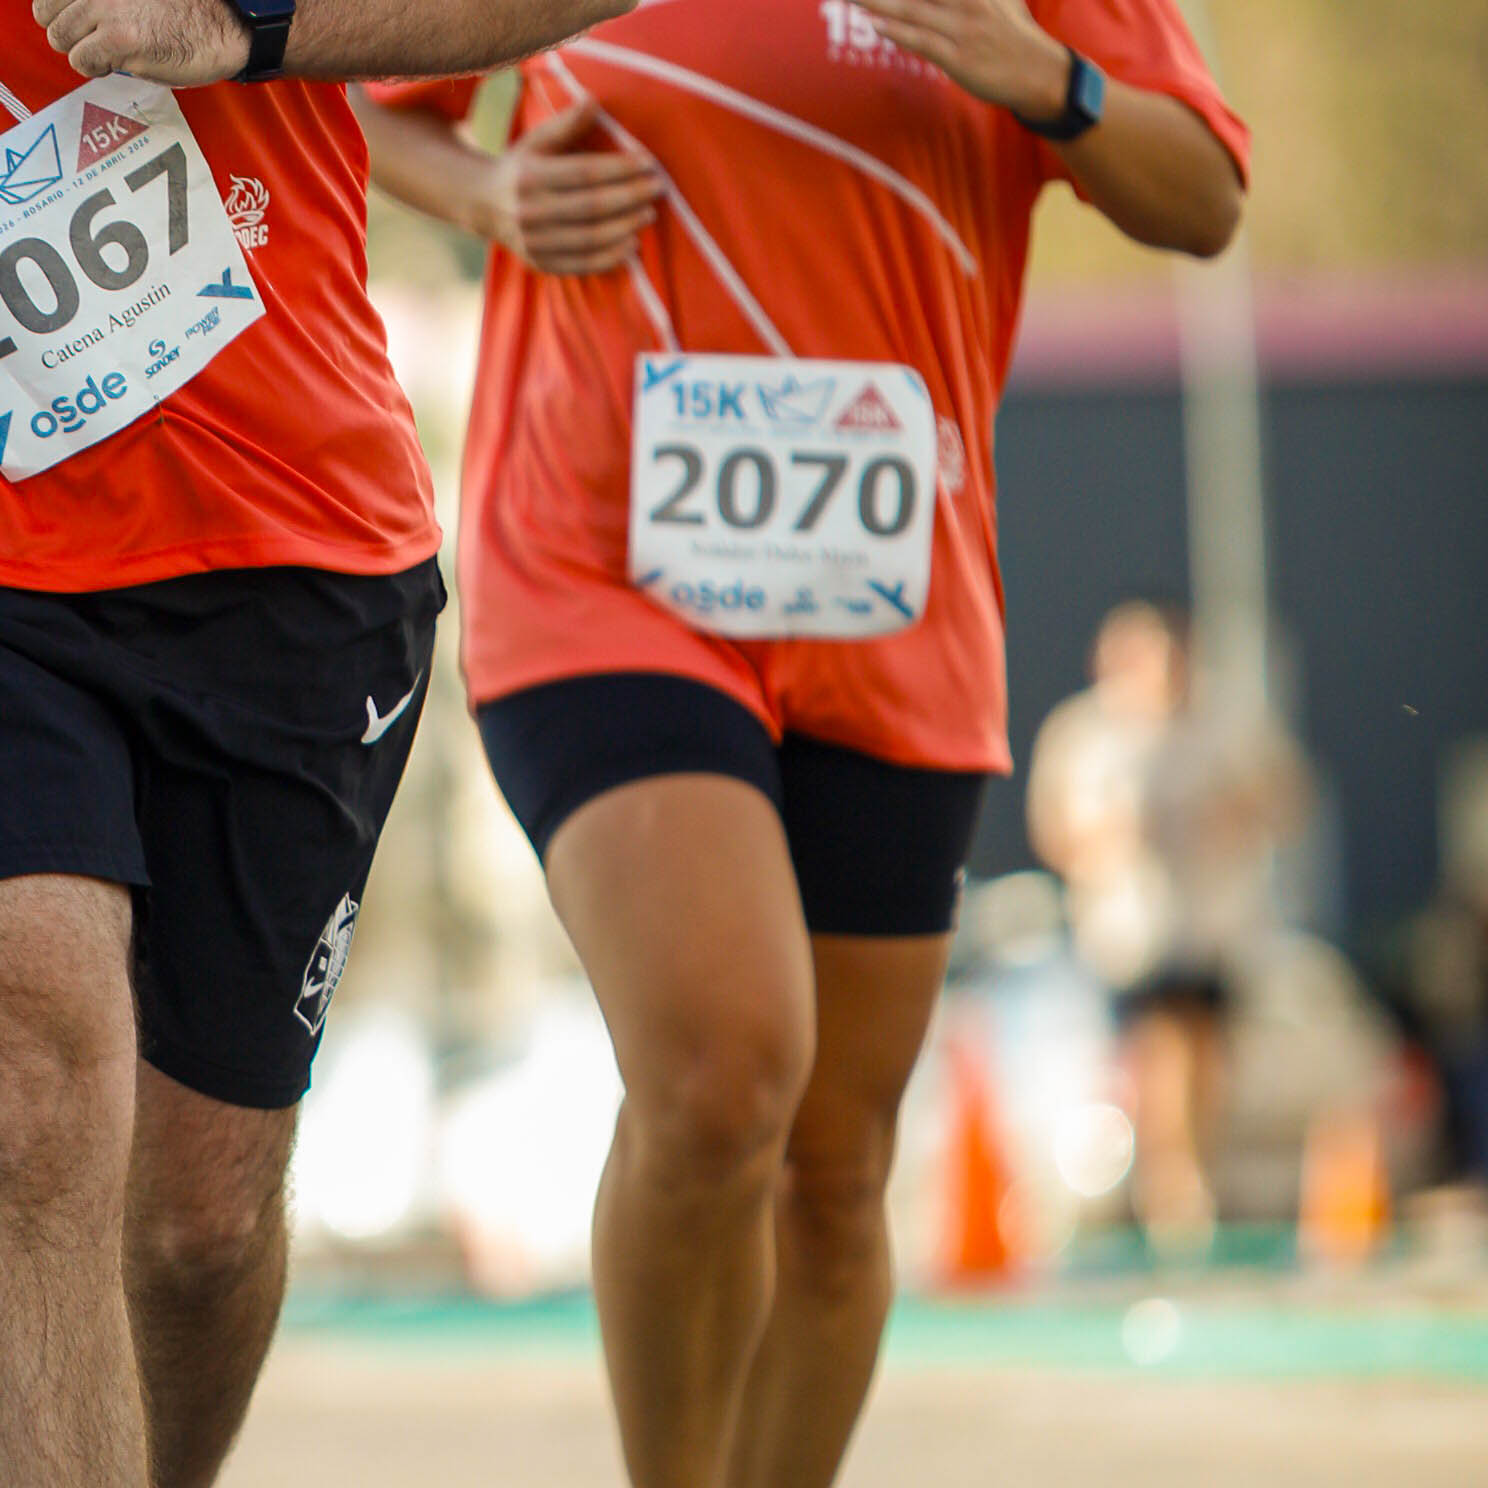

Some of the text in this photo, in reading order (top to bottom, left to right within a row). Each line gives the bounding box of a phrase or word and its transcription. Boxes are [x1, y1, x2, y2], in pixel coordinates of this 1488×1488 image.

[83, 116, 129, 153] 15K
[23, 189, 65, 219] ROSARIO
[72, 175, 85, 189] 12
[86, 167, 99, 181] DE
[100, 152, 127, 173] ABRIL
[41, 325, 105, 369] Catena
[106, 282, 172, 334] Agustin
[31, 371, 128, 438] osde
[671, 379, 747, 420] 15K
[649, 442, 917, 538] 2070
